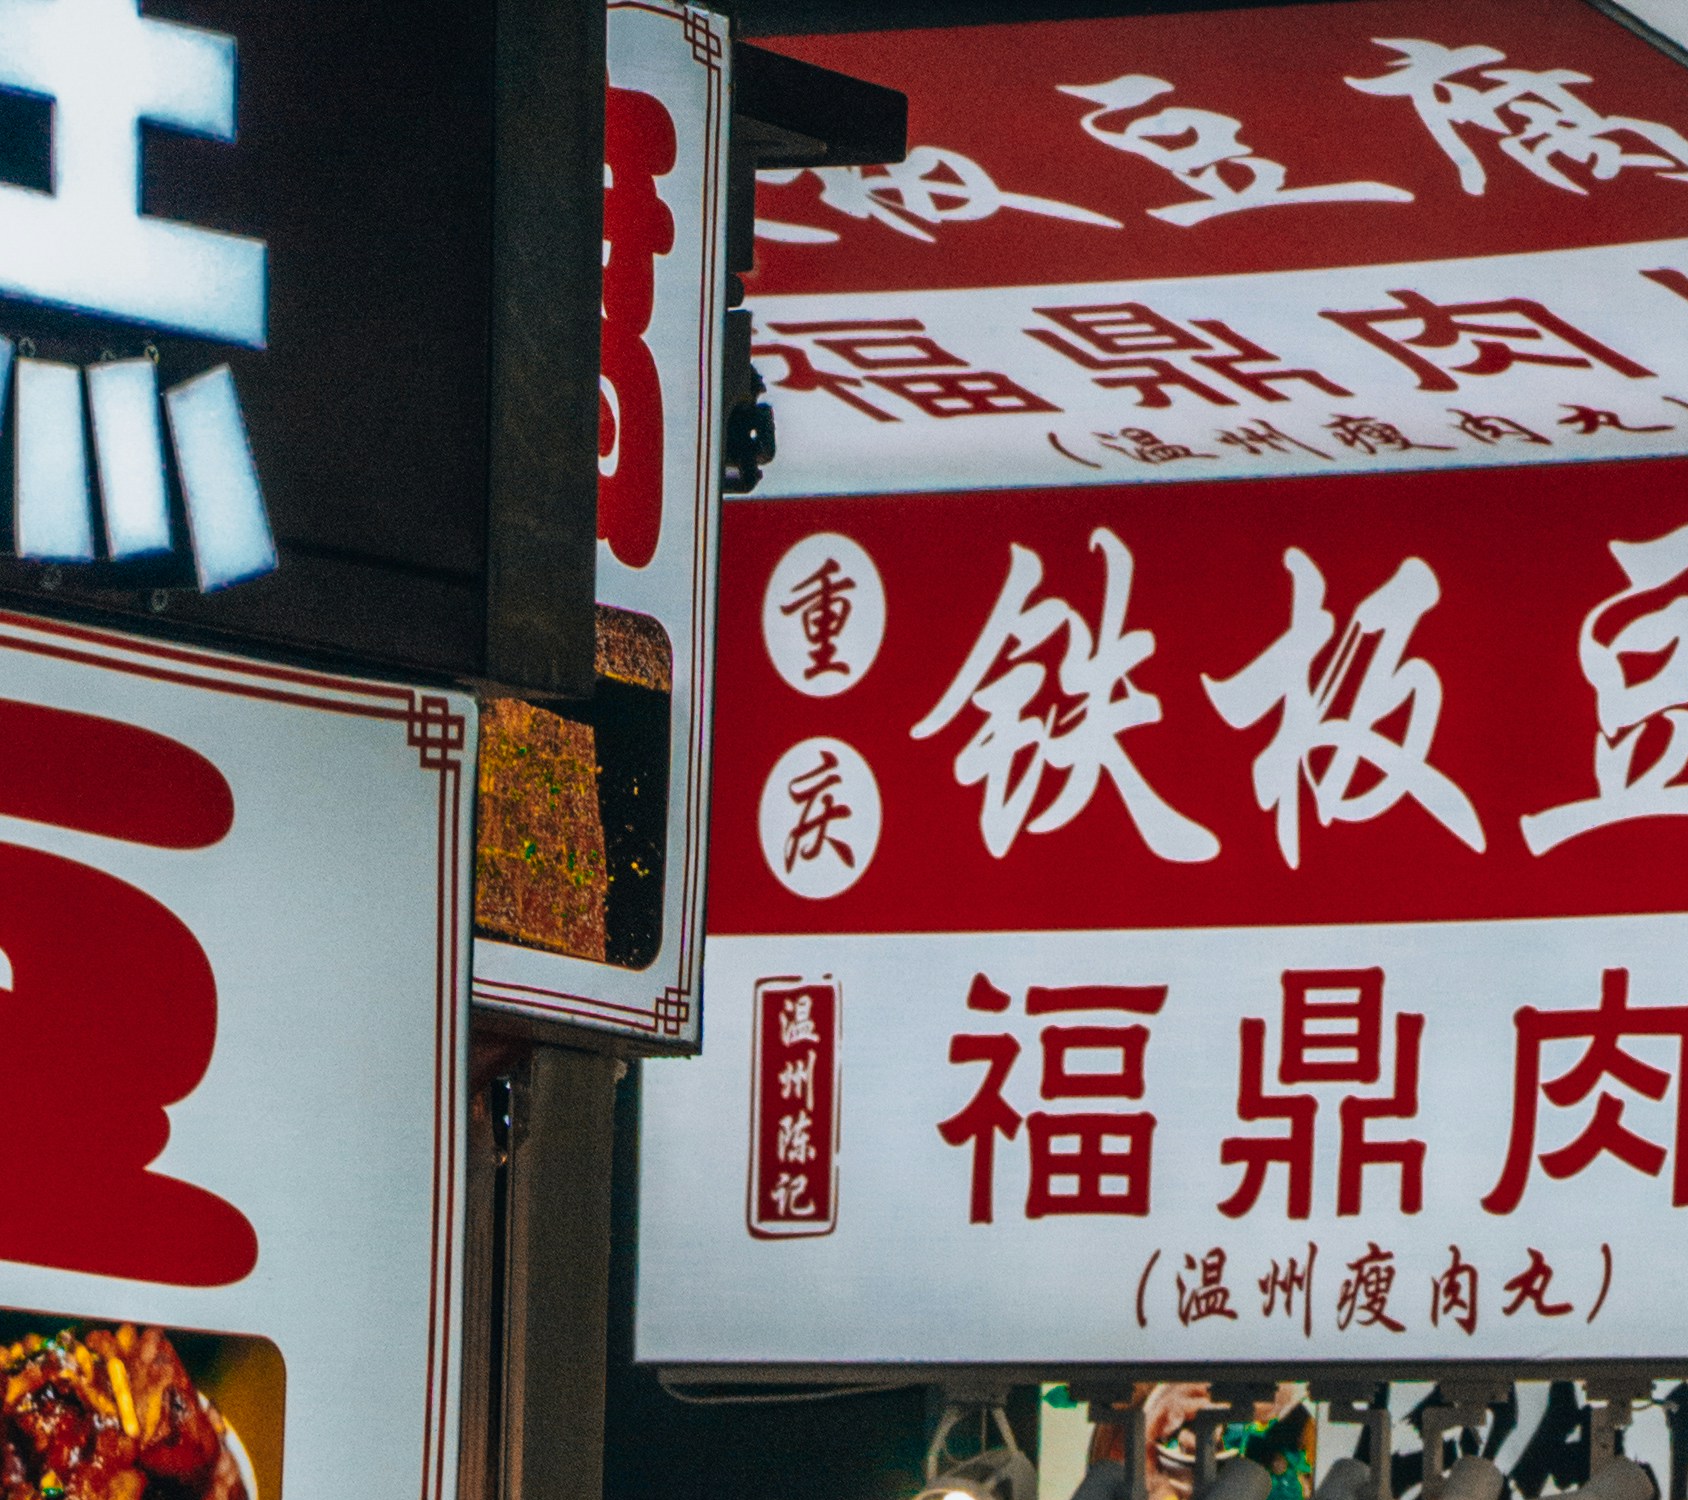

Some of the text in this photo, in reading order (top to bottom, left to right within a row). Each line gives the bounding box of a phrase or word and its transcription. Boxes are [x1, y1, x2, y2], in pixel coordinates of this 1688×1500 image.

[771, 995, 820, 1216] 温州陈记
[1136, 1241, 1611, 1338] (温州瘦肉丸)
